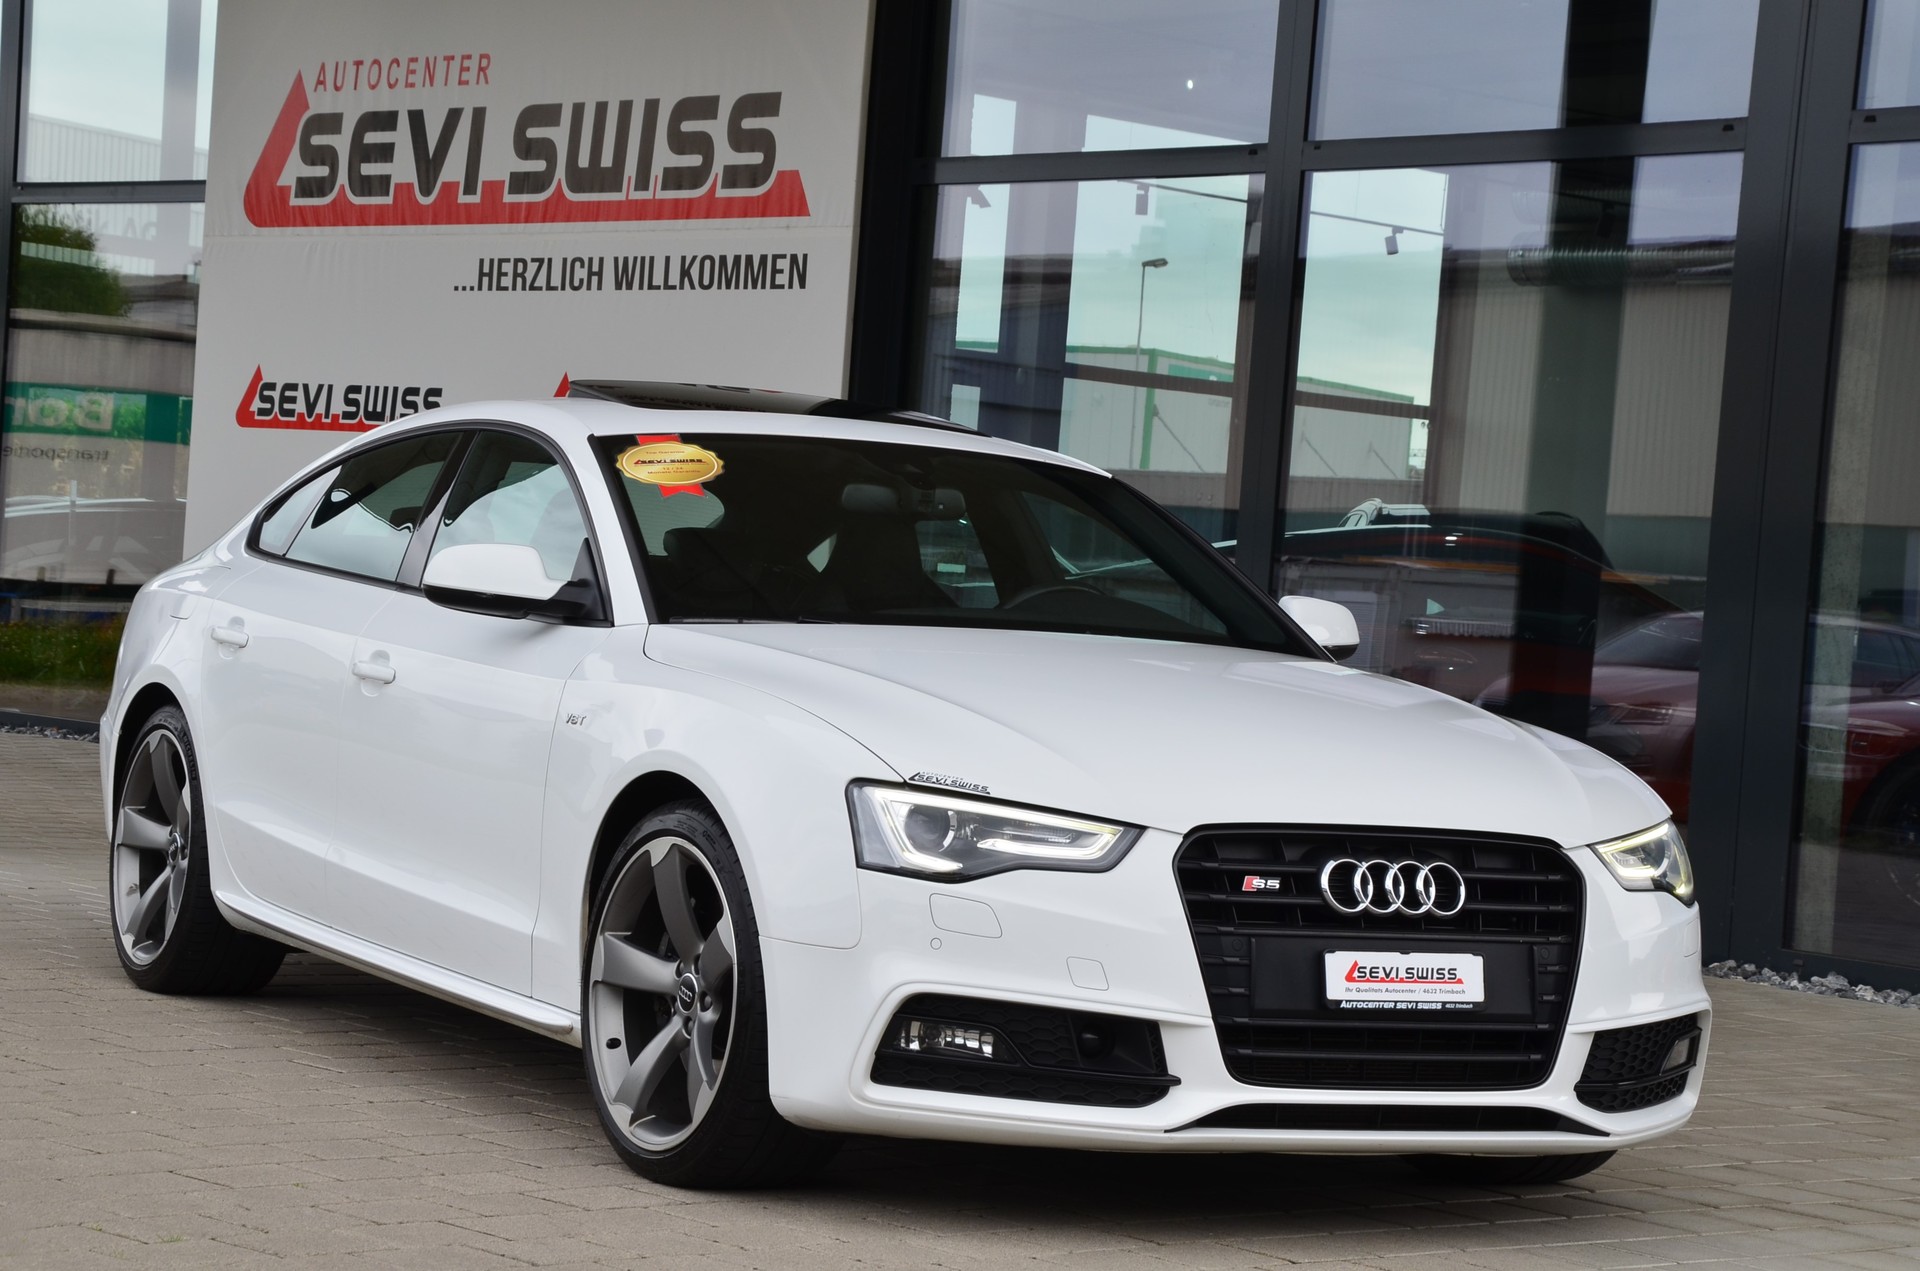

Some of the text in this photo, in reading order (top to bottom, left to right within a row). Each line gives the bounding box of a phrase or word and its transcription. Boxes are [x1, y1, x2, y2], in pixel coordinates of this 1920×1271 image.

[313, 53, 492, 93] AUTOCENTER
[294, 91, 782, 198] SEVI SWISS
[453, 253, 809, 292] ...HERZLICH WILLKOMMEN
[256, 381, 334, 420] SEVI
[917, 774, 989, 792] SEVI SWISS
[1251, 878, 1281, 889] S5
[1356, 966, 1458, 981] SEVI SWISS
